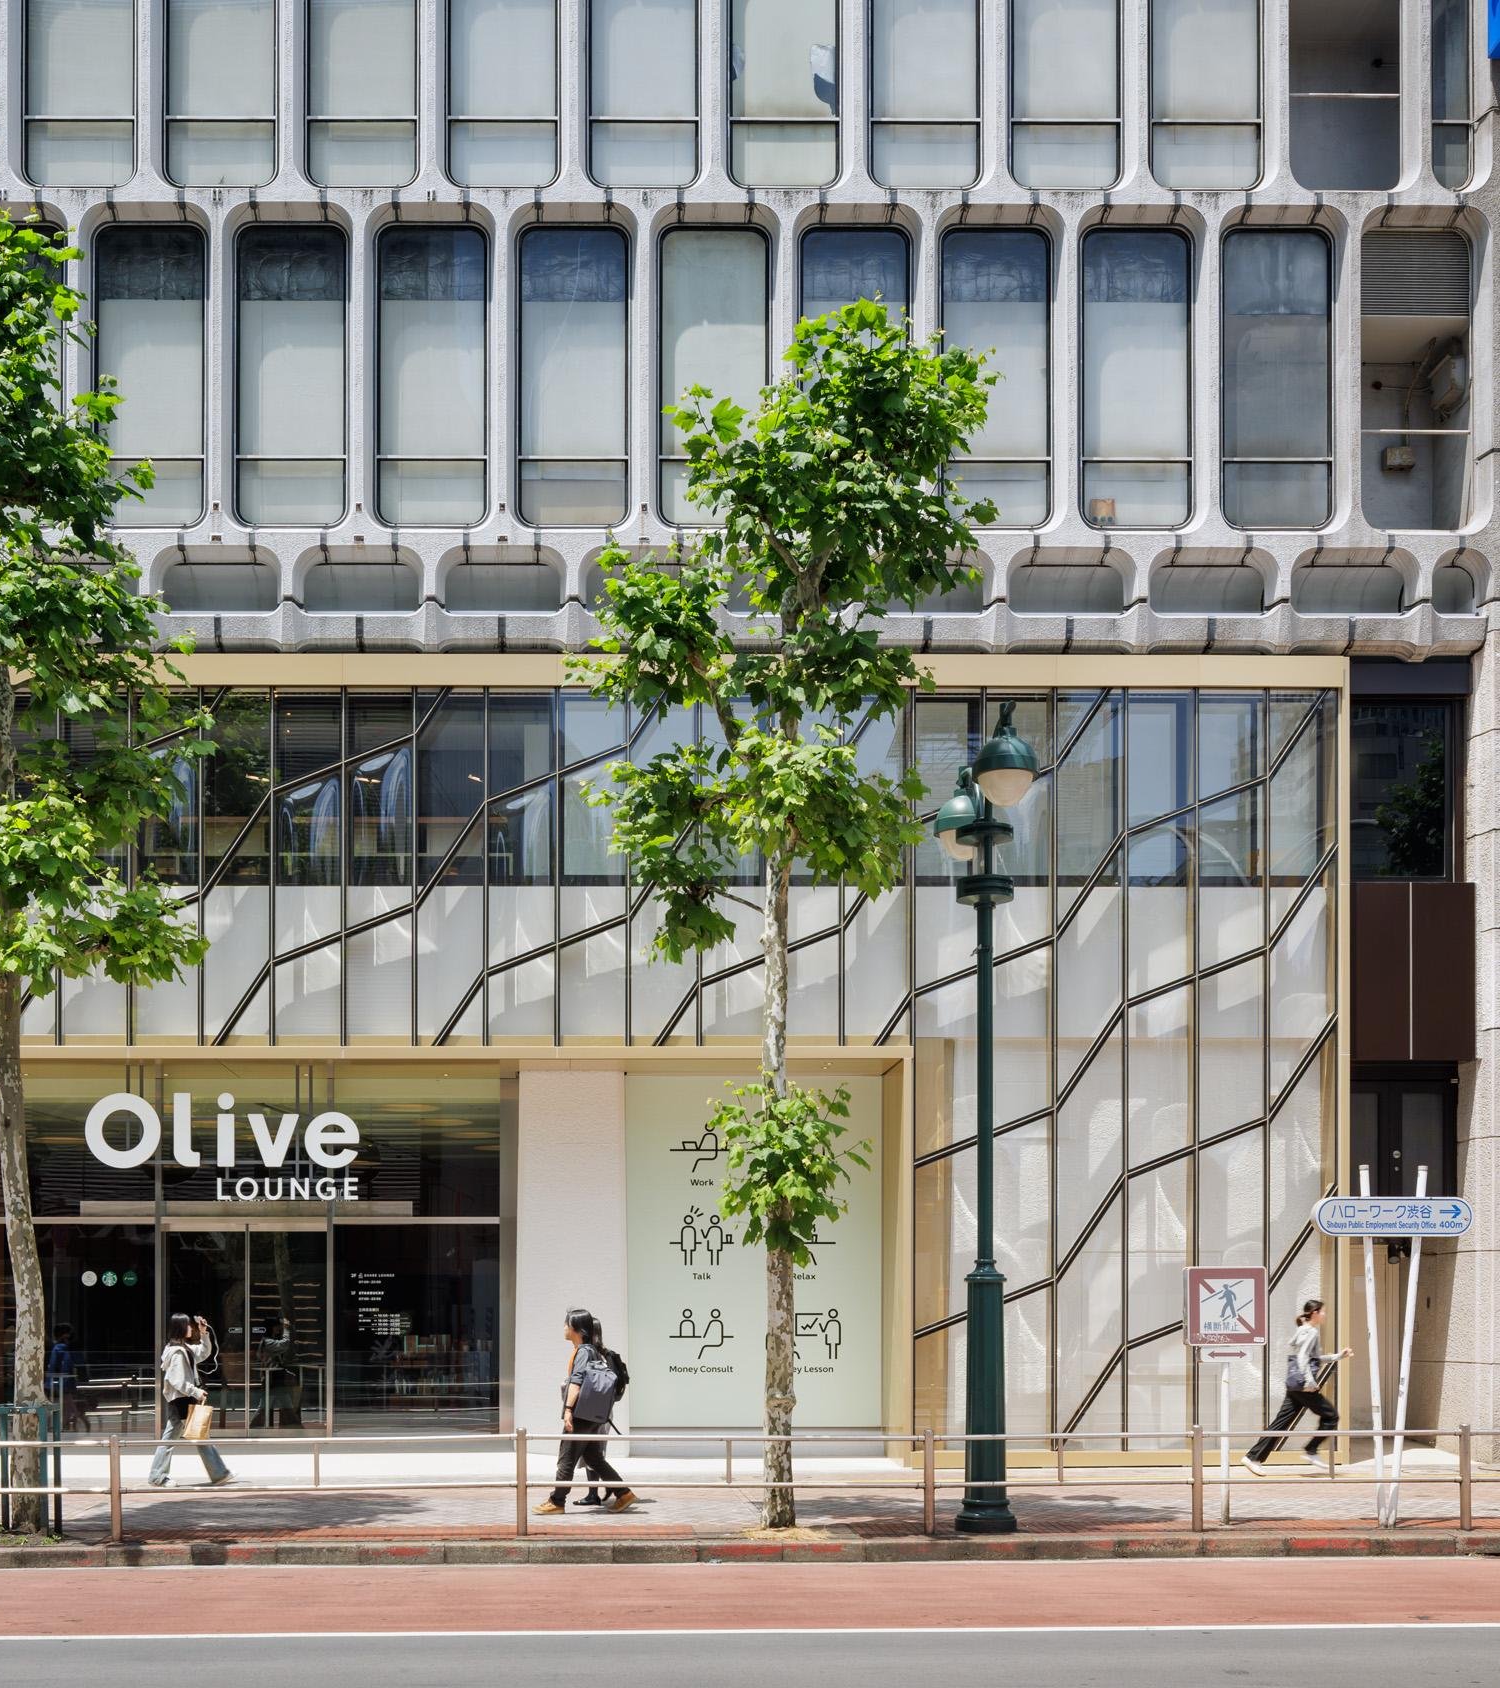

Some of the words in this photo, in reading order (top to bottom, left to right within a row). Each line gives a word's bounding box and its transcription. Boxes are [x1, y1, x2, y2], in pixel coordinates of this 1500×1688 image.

[84, 1092, 361, 1169] Olive
[690, 1178, 715, 1187] Work
[216, 1177, 359, 1202] LOUNGE
[1331, 1204, 1432, 1219] ハローワーク渋谷
[1327, 1220, 1347, 1230] Shibuya
[1348, 1220, 1364, 1229] Public
[1365, 1220, 1397, 1230] Employment
[1398, 1220, 1420, 1230] Security
[1420, 1220, 1437, 1229] Office
[1439, 1220, 1463, 1229] 400m
[692, 1271, 712, 1281] Talk
[1203, 1321, 1240, 1332] 横断禁止
[669, 1365, 699, 1375] Money
[700, 1364, 734, 1373] Consult
[804, 1365, 834, 1373] Lesson
